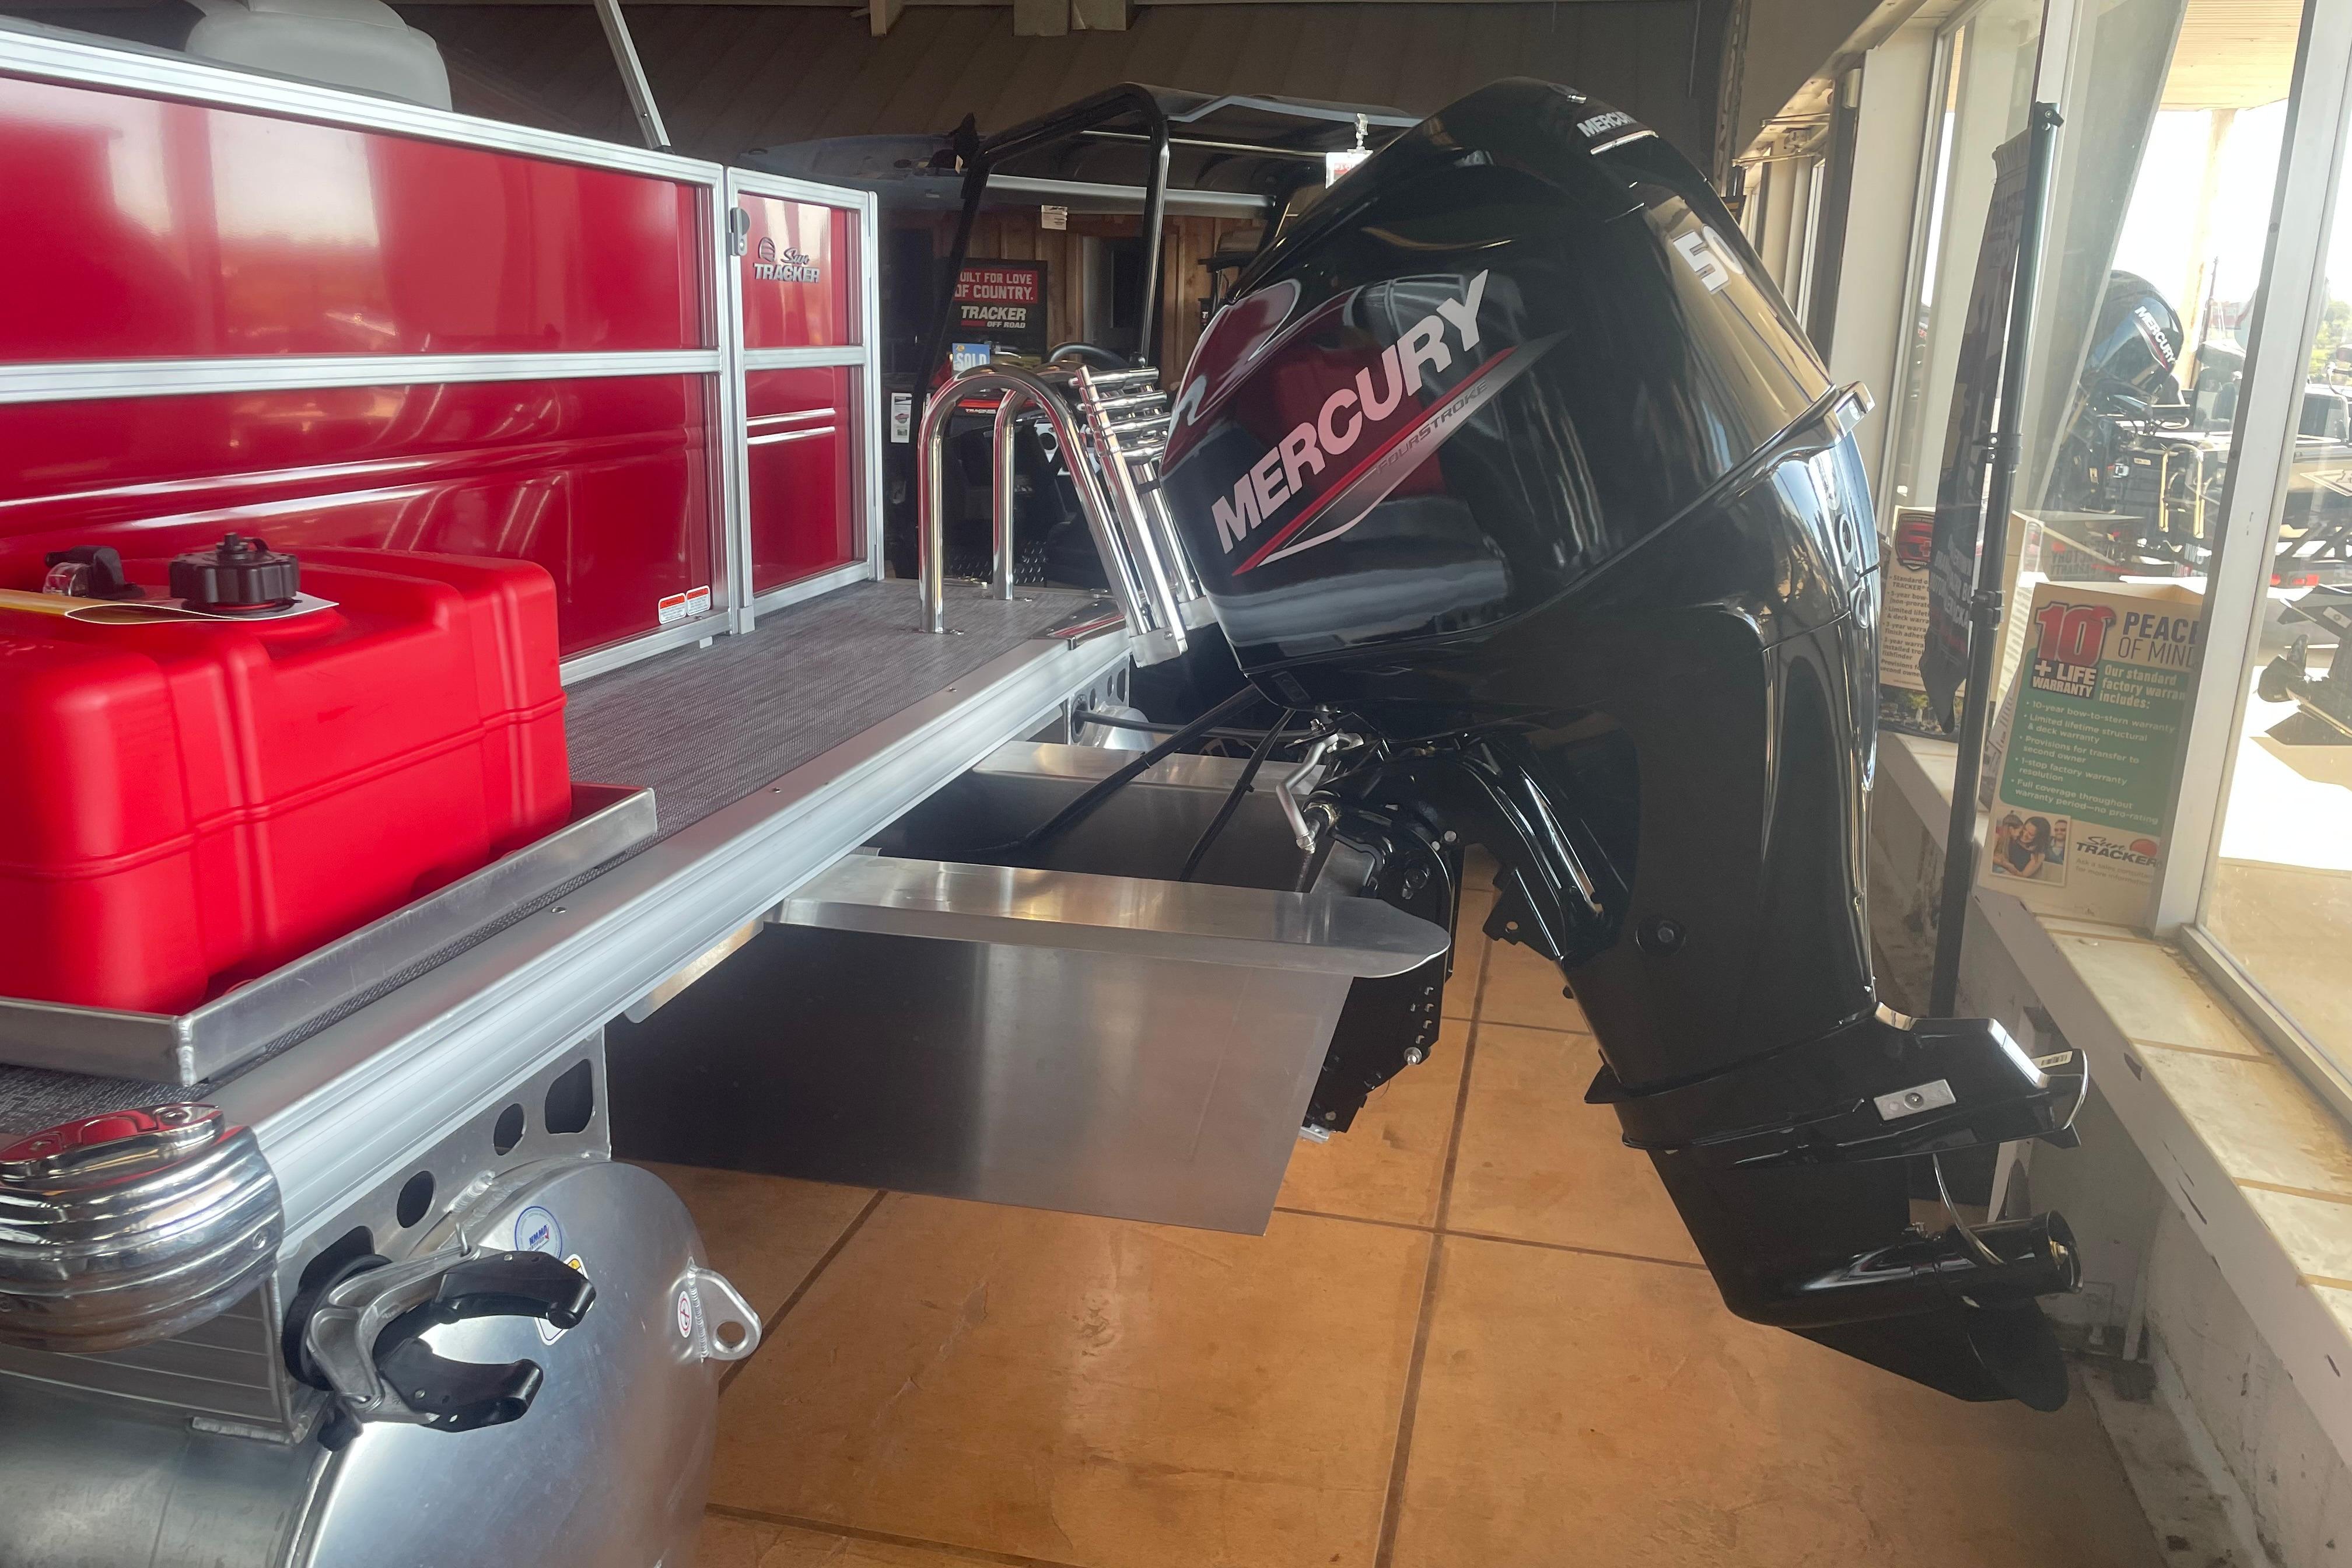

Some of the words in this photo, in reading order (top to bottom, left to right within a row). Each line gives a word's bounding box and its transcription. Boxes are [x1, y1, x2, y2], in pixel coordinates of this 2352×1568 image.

[752, 262, 820, 284] TRACKER
[959, 272, 981, 282] UILT
[984, 272, 1003, 284] FOR
[1006, 274, 1032, 285] LOVE
[973, 285, 1034, 300] COUNTRY.
[961, 306, 1027, 321] TRACKER
[2134, 306, 2176, 364] MERCURY
[956, 352, 987, 370] SOLD
[1211, 268, 1489, 554] MERCURY
[1377, 379, 1488, 474] FOURSTROKE
[1888, 606, 1912, 615] Limited
[2035, 601, 2112, 668] 10
[2118, 637, 2144, 659] OF
[2057, 663, 2097, 685] LIFE
[2105, 664, 2124, 678] Our
[2126, 668, 2178, 685] standard
[2032, 676, 2093, 698] WARRANTY
[2102, 677, 2144, 696] factory
[2146, 686, 2186, 701] warran
[2099, 690, 2151, 709] includes:
[2029, 713, 2063, 727] Limited
[2065, 720, 2100, 734] lifetime
[2102, 729, 2148, 741] structural
[2032, 701, 2065, 713] 10-year
[2067, 708, 2129, 725] bow-to-stern
[2132, 720, 2175, 733] warranty
[2036, 725, 2058, 736] deck
[2060, 730, 2101, 744] warranty
[2023, 746, 2055, 758] second
[2057, 753, 2087, 764] owner
[2025, 735, 2071, 751] Provisions
[2073, 744, 2087, 754] for
[2089, 748, 2127, 761] transfer
[2019, 767, 2064, 782] resolution
[2050, 763, 2083, 778] factory
[2085, 771, 2128, 786] warranty
[2017, 778, 2034, 789] Full
[2035, 784, 2077, 799] coverage
[2079, 792, 2134, 810] throughout
[2015, 789, 2054, 804] warranty
[2108, 808, 2159, 825] pro-rating
